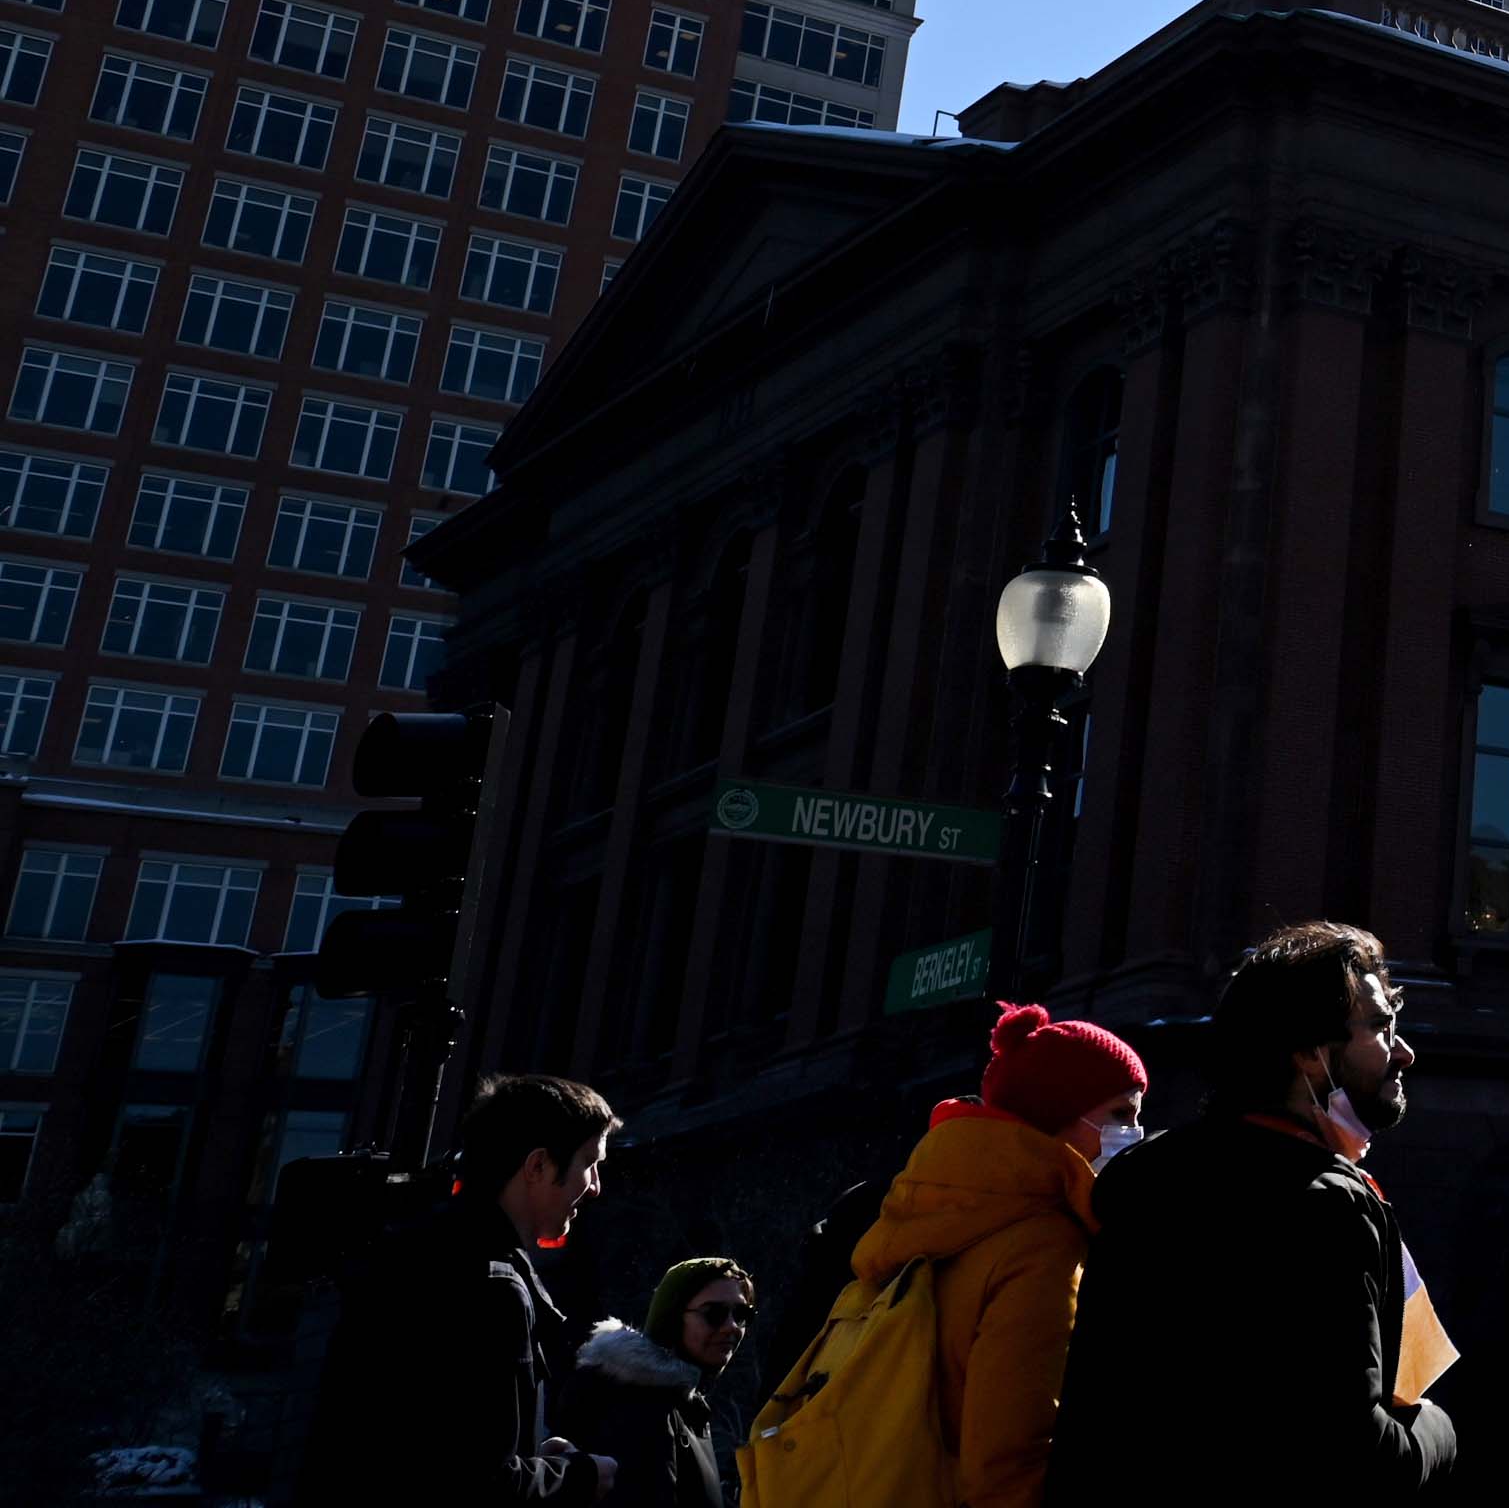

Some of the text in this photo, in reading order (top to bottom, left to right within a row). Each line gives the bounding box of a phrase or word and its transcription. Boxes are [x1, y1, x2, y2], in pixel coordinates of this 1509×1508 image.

[791, 795, 962, 851] NEWBURY ST
[911, 939, 983, 999] BERKELEY ST
